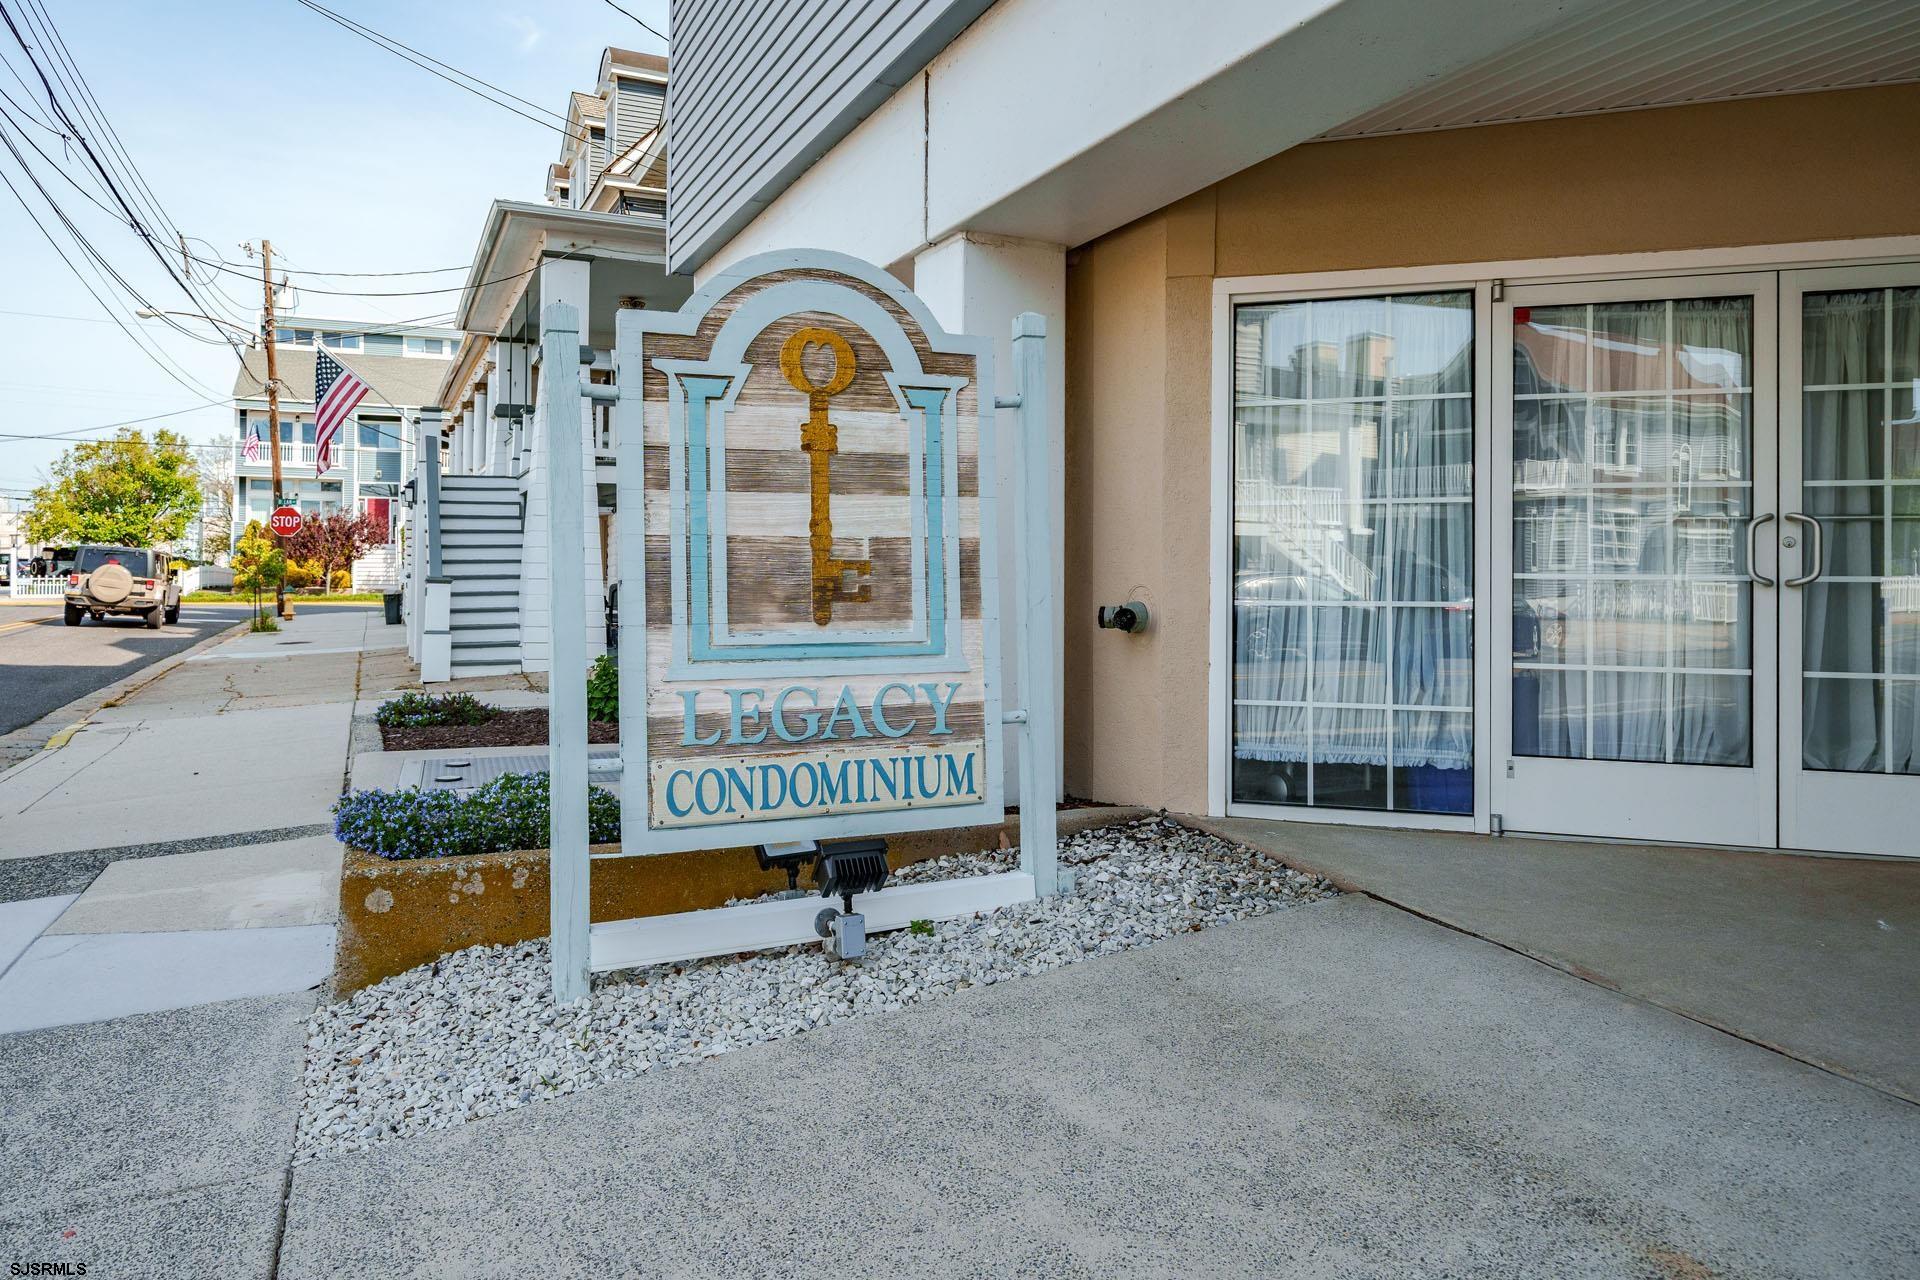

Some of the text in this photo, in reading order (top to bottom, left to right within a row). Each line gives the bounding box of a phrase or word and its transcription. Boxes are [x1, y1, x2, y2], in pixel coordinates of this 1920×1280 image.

[272, 516, 300, 527] STOP
[676, 682, 961, 746] LEGACY
[665, 753, 977, 817] CONDOMINIUM
